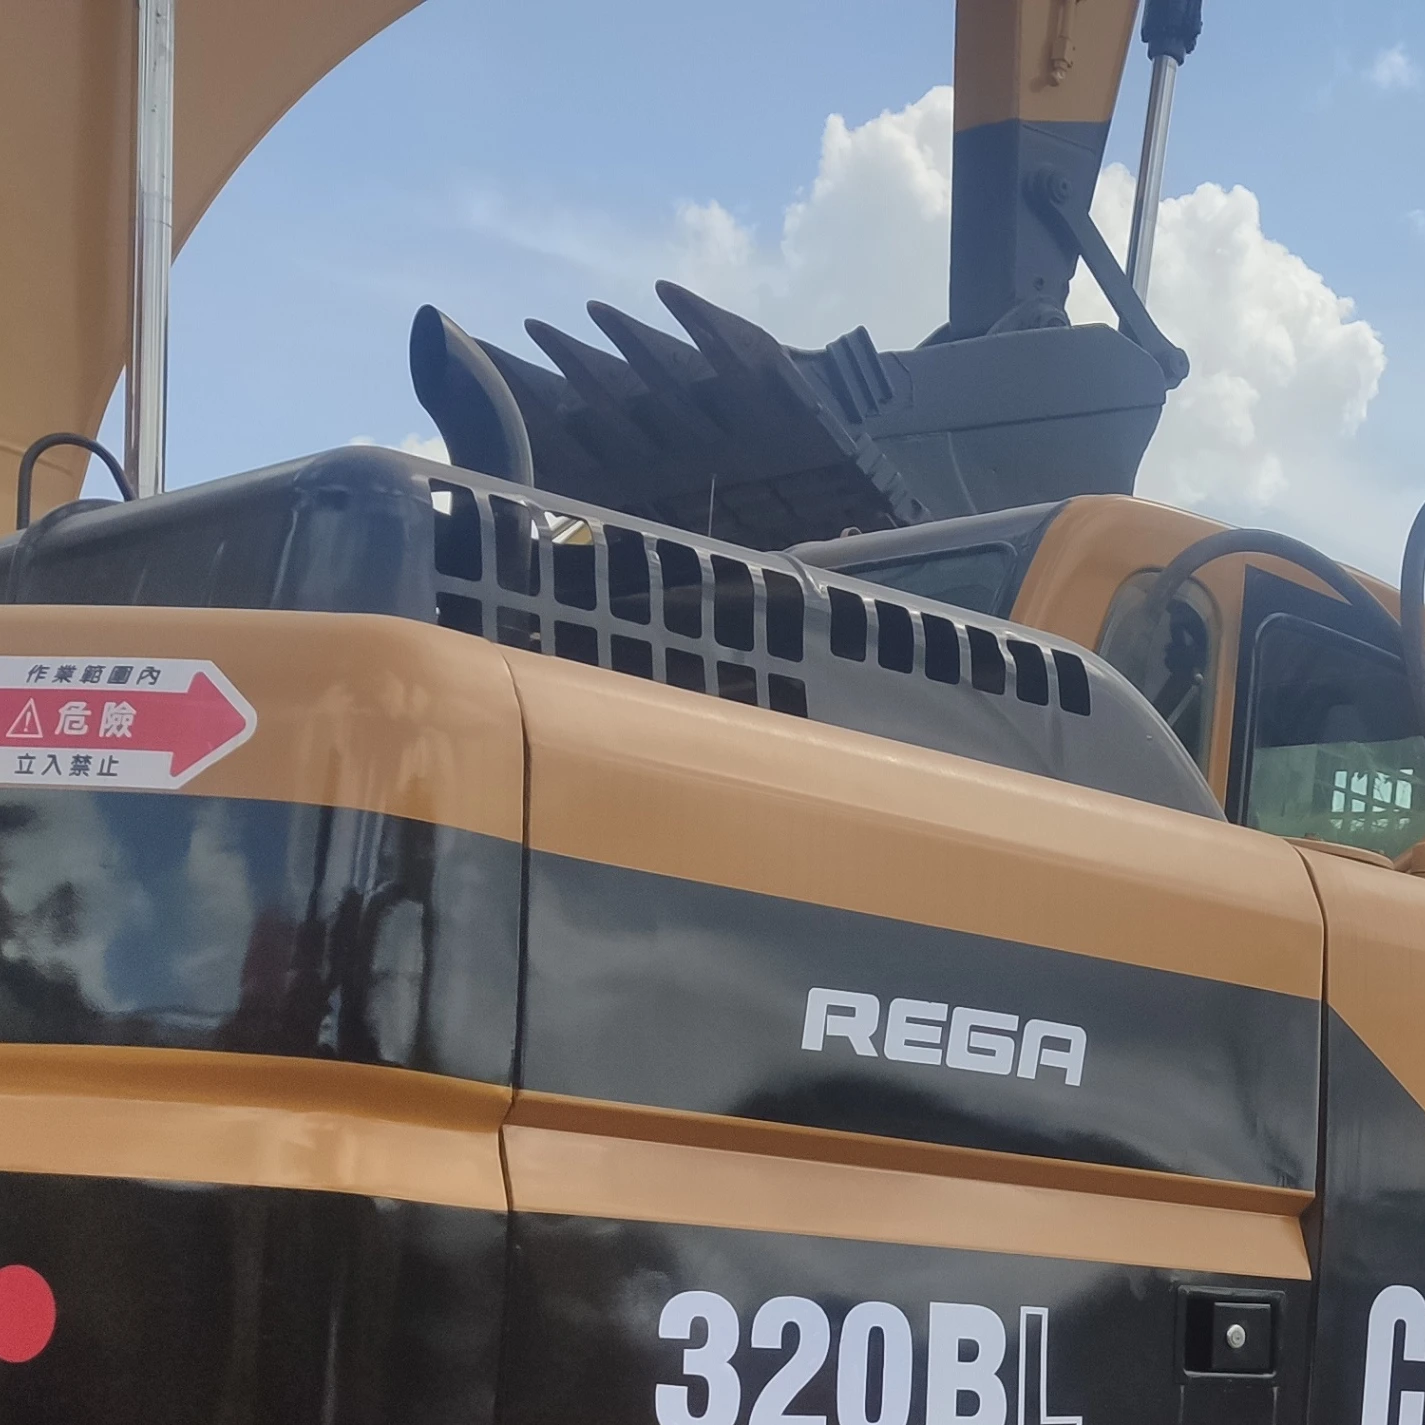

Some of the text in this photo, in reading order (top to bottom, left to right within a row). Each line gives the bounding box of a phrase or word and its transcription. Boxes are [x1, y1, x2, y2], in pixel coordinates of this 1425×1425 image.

[54, 701, 138, 738] 危險
[14, 753, 120, 778] 立入禁止
[801, 987, 1087, 1087] REGA
